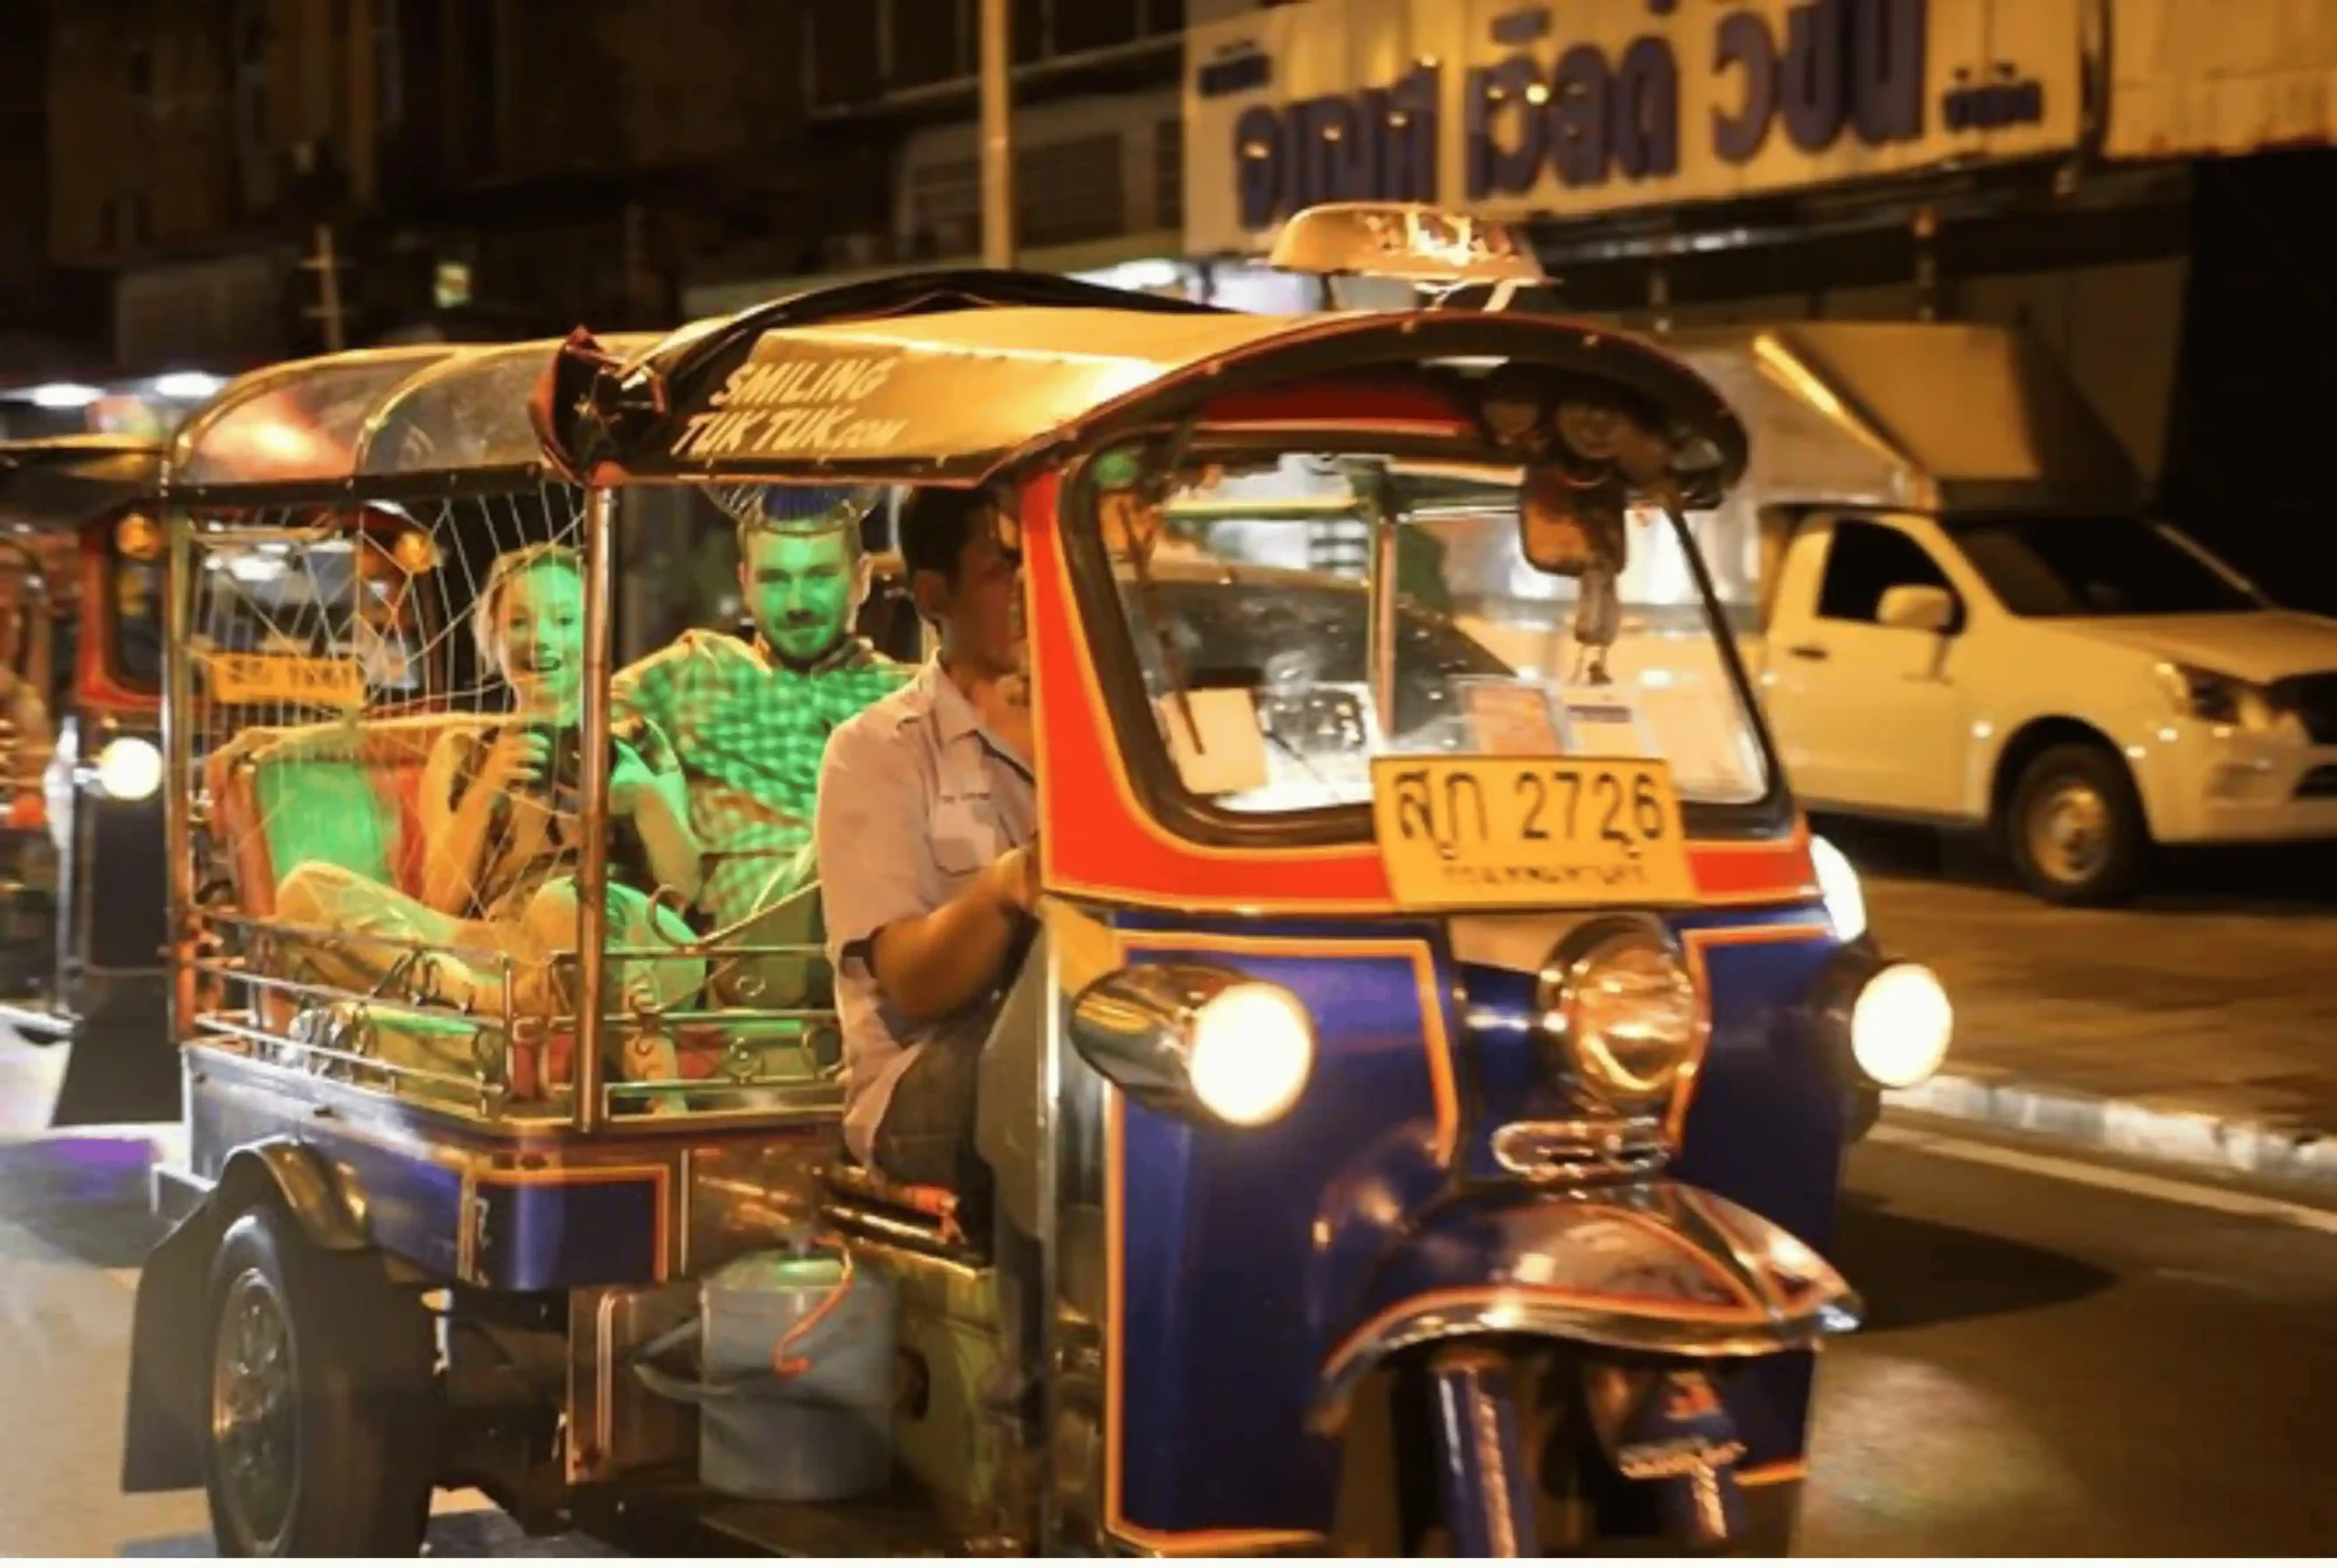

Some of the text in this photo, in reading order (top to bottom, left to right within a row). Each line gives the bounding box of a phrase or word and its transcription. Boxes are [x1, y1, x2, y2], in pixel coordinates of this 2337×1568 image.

[708, 358, 904, 407] SMILING
[670, 409, 769, 456] TUK
[1515, 771, 1665, 840] 2726
